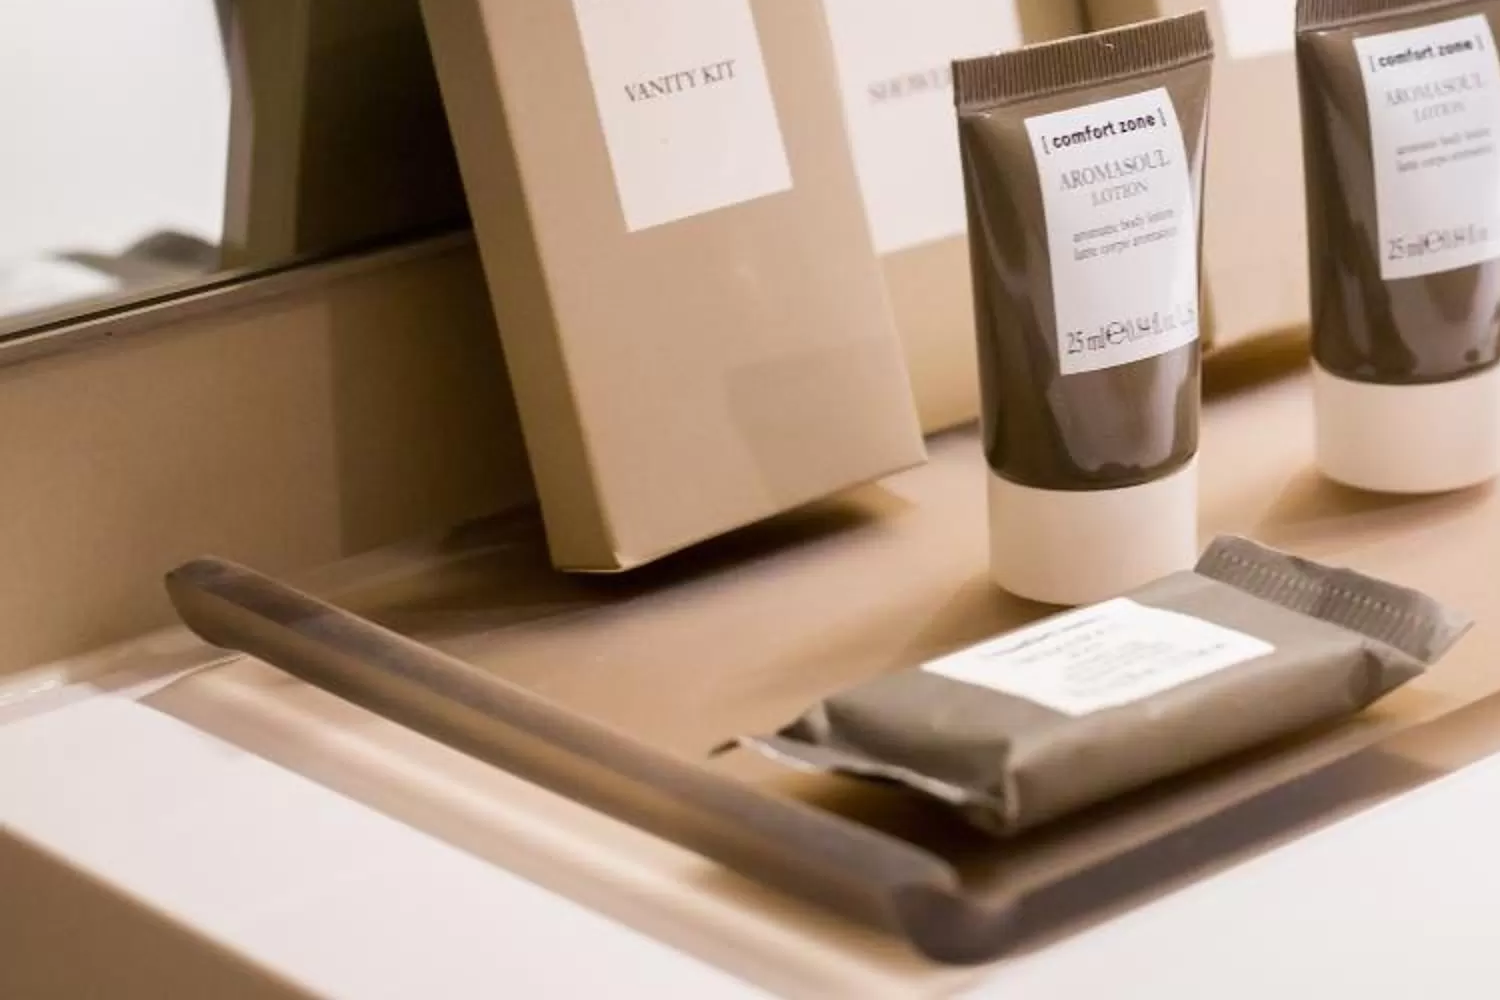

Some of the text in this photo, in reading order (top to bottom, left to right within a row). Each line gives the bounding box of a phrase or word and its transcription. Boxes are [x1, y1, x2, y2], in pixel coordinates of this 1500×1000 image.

[1378, 46, 1434, 68] comfort
[1437, 39, 1473, 57] zone
[624, 59, 737, 103] VANITY KIT
[1052, 121, 1117, 149] comfort
[1118, 114, 1156, 133] zone
[1060, 148, 1172, 192] AROMASOUL
[1091, 180, 1149, 207] LOTION
[1066, 331, 1085, 355] 25
